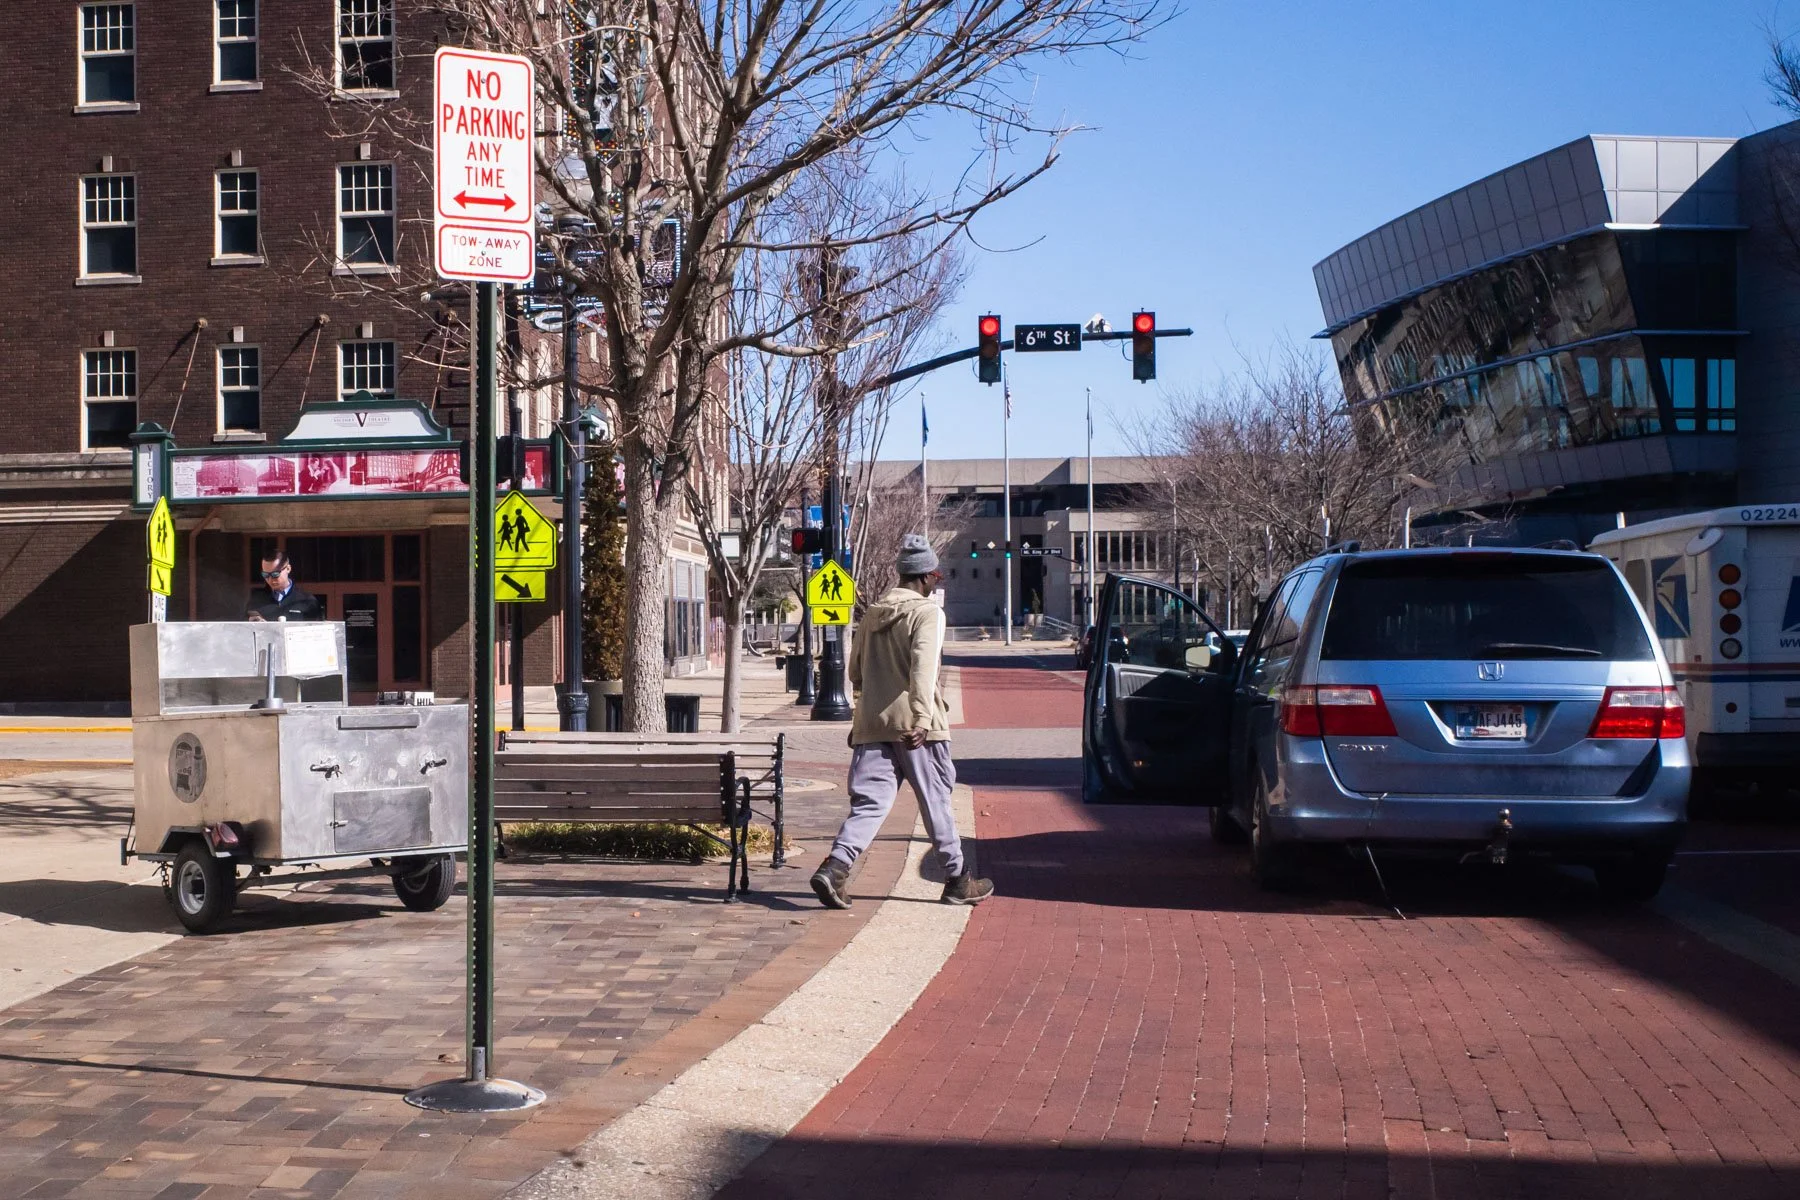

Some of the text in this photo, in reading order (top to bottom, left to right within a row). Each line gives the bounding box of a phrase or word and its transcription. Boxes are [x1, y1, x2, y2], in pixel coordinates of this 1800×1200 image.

[467, 69, 501, 100] NO
[443, 103, 525, 140] PARKING
[467, 141, 502, 163] ANY
[465, 166, 505, 188] TIME
[469, 255, 502, 268] ZONE
[1026, 330, 1070, 345] 6TH St
[354, 412, 369, 428] V
[1741, 507, 1798, 521] 02224
[154, 595, 165, 611] ONE
